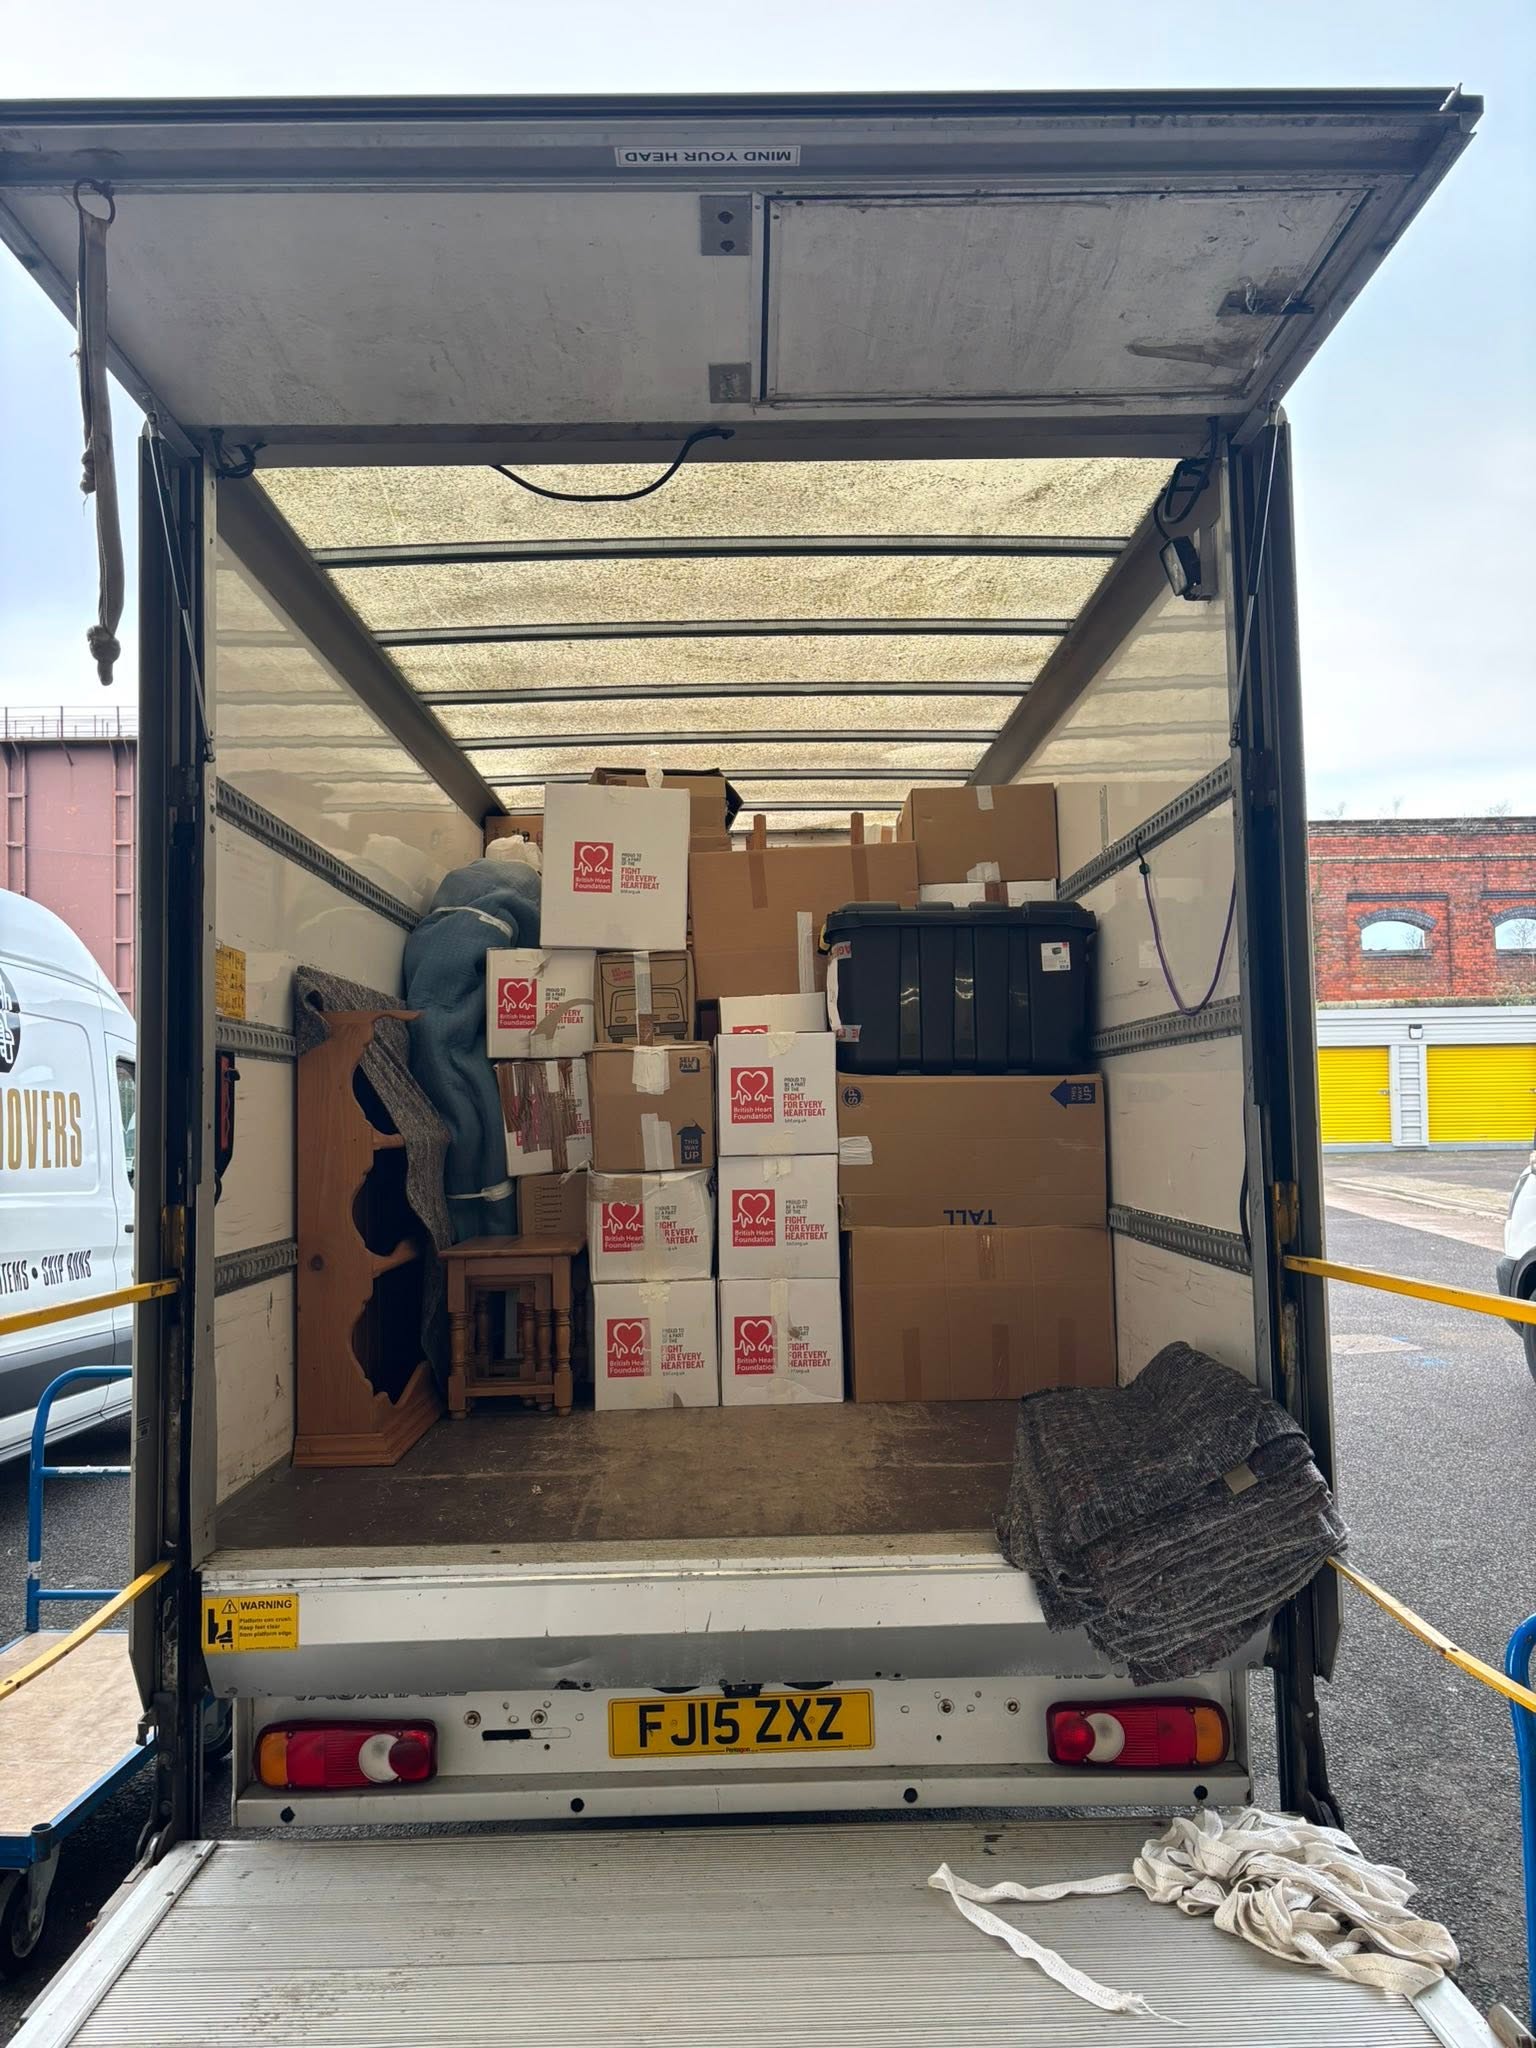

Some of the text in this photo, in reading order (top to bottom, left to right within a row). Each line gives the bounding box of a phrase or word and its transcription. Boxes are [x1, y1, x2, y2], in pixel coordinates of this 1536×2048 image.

[624, 151, 791, 162] MIND YOUR HEAD
[620, 882, 660, 890] HEARTBEAT
[1083, 1086, 1092, 1100] UP
[0, 1087, 82, 1170] OVERS
[684, 1152, 700, 1160] UP
[944, 1209, 996, 1225] TALL
[671, 1228, 695, 1236] EVERY
[666, 1236, 698, 1244] ARTBEAT
[41, 1254, 64, 1286] SKIP
[67, 1250, 92, 1281] RUNS
[661, 1345, 683, 1353] FIGHT
[677, 1352, 701, 1360] EVERY
[661, 1360, 705, 1370] HEARTBEAT
[788, 1359, 831, 1367] HEARTBEAT
[240, 1600, 292, 1610] WARNING
[756, 1697, 844, 1743] ZXZ
